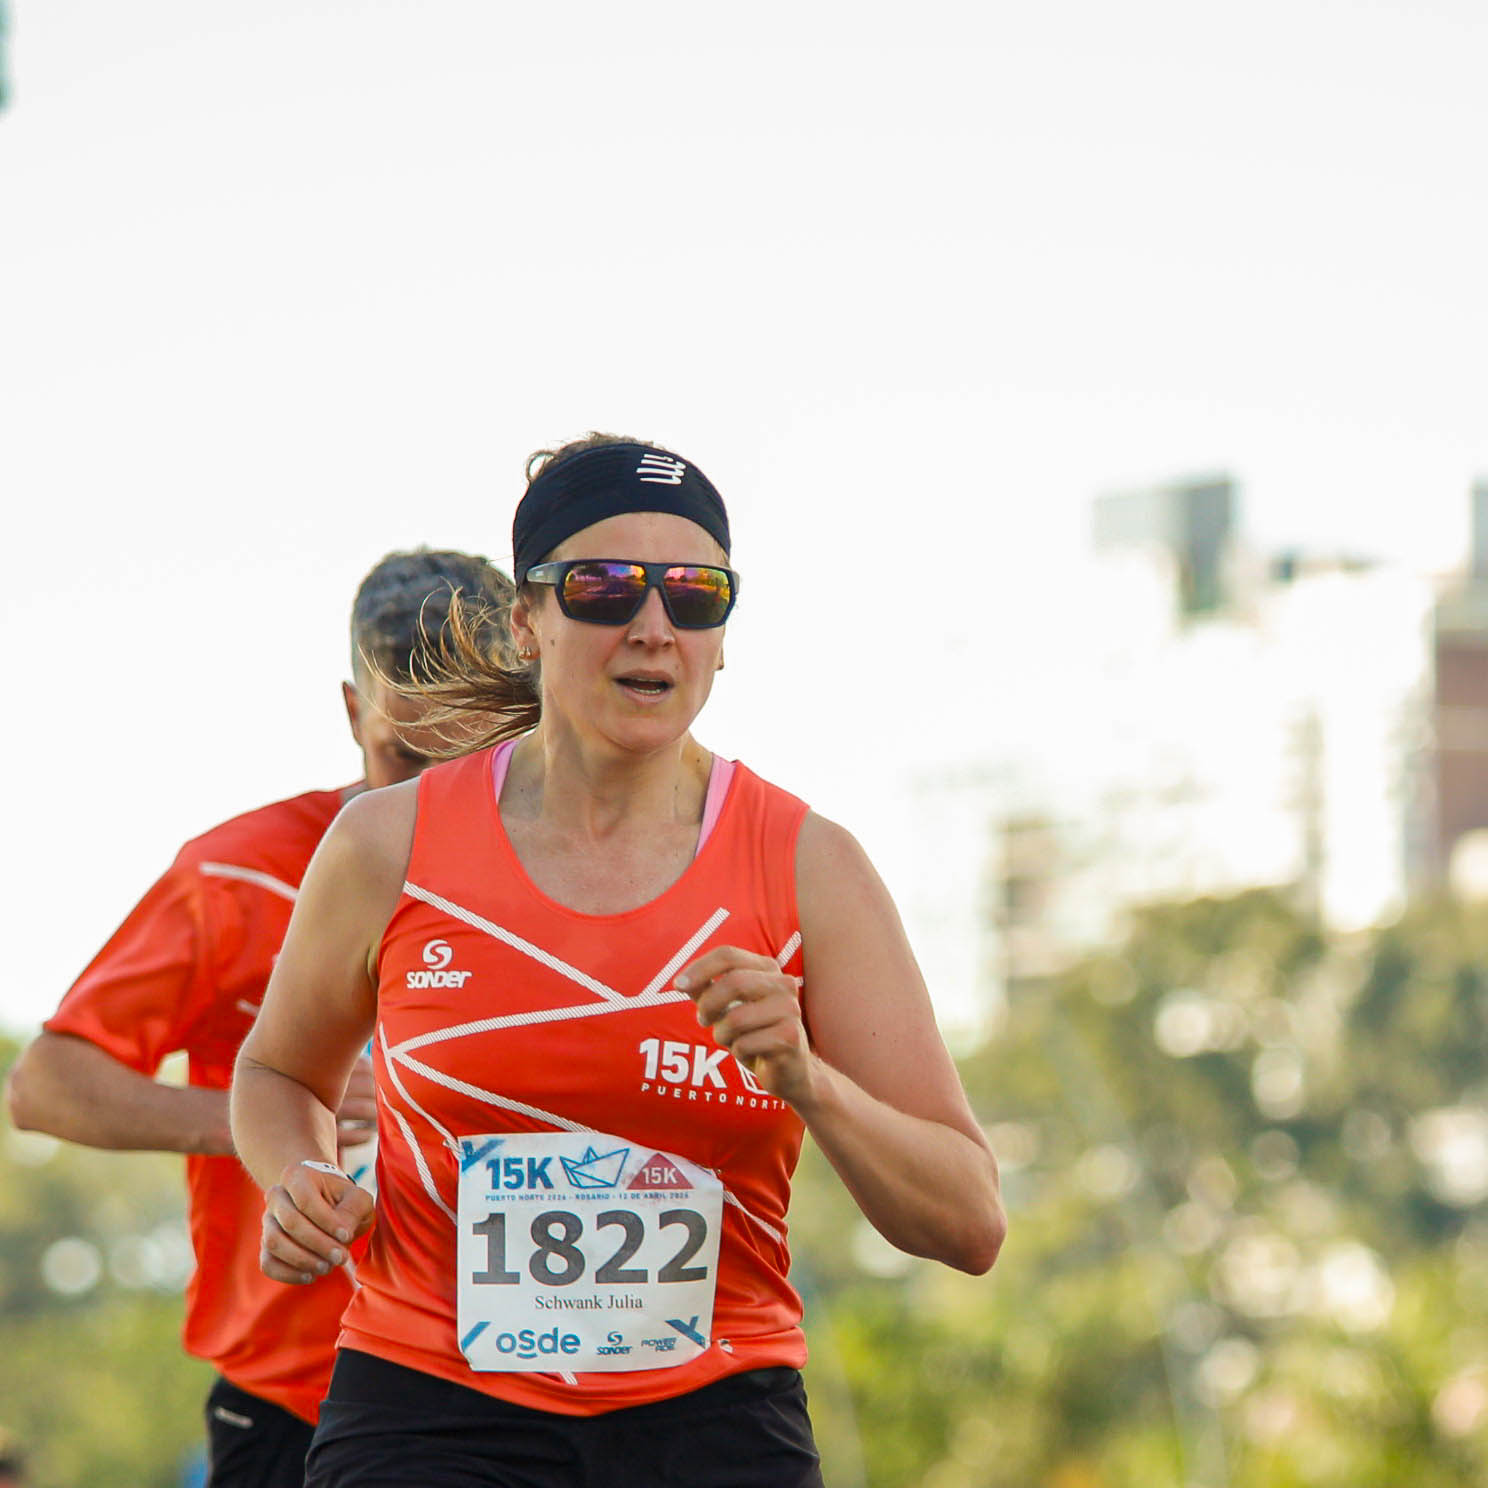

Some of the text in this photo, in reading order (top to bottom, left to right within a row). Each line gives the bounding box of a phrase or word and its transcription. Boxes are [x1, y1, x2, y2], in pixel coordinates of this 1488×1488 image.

[639, 1037, 730, 1089] 15K
[640, 1082, 728, 1104] PUERTO
[486, 1157, 554, 1189] 15K
[642, 1167, 678, 1185] 15K
[472, 1209, 708, 1286] 1822
[535, 1294, 643, 1310] Schwank Julia
